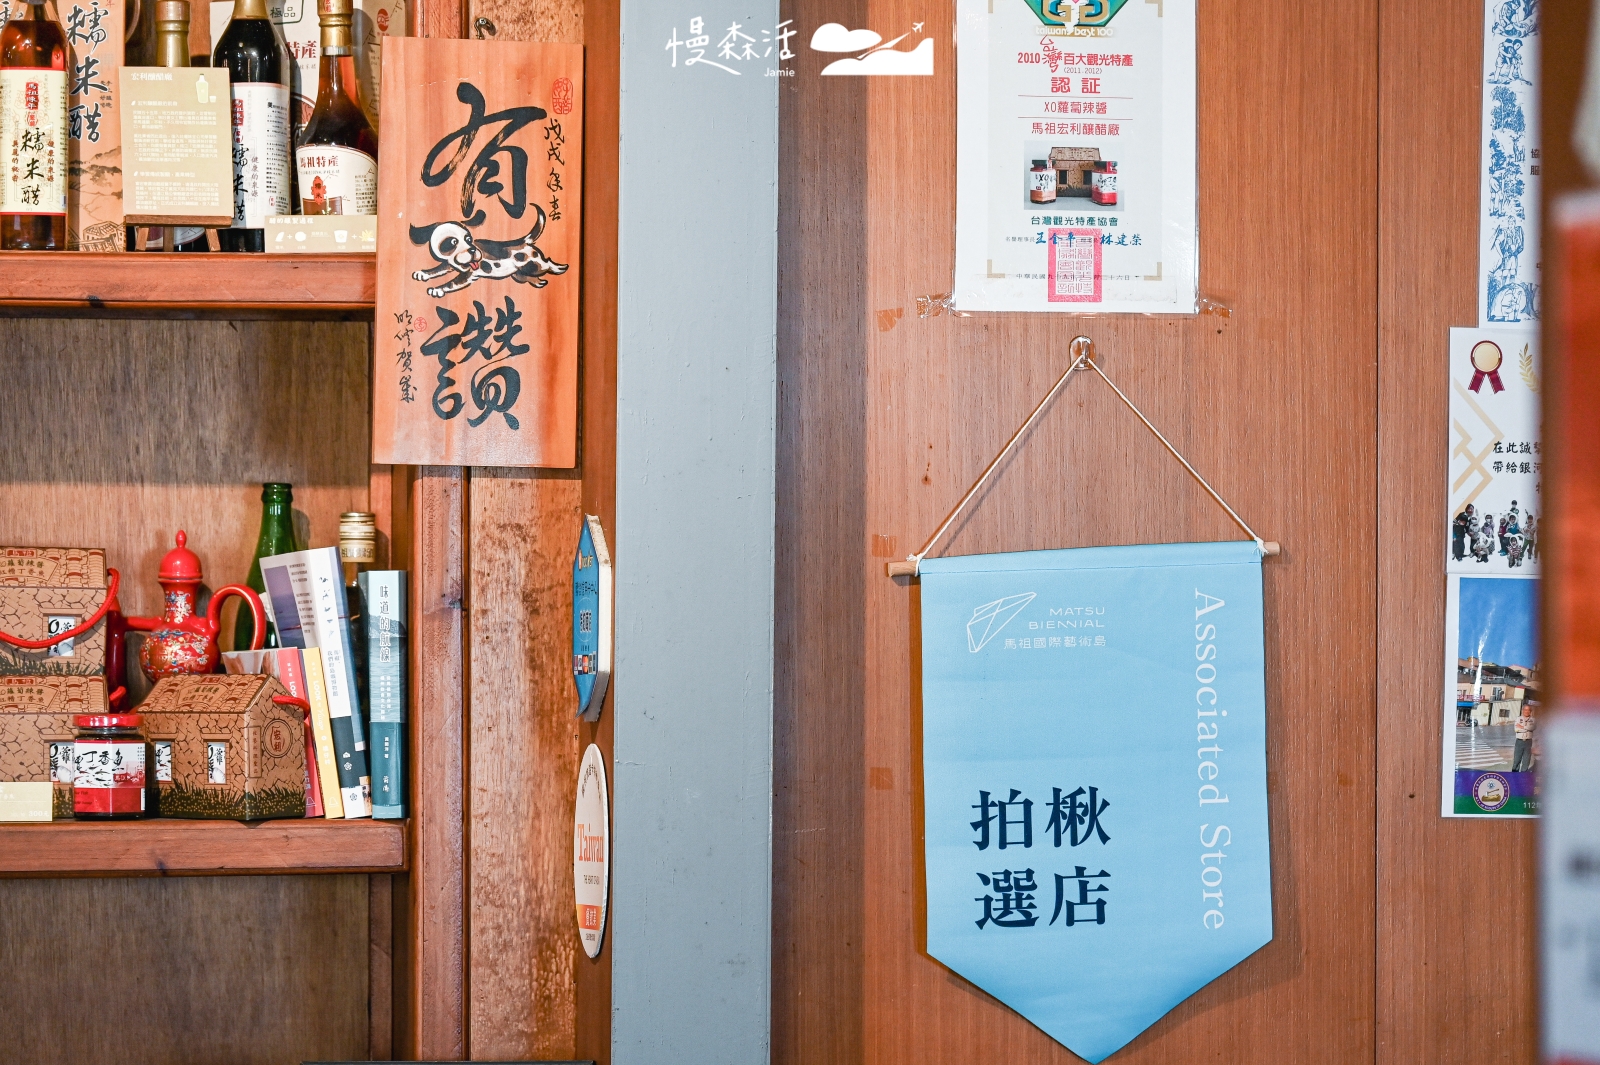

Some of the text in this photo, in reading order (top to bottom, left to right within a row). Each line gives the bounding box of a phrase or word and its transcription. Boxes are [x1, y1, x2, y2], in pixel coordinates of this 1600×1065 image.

[1031, 122, 1120, 136] 馬祖宏利釀醋廠
[1031, 215, 1118, 227] 台灣觀光特產協會
[420, 295, 531, 431] 讚
[1049, 606, 1105, 617] MATSU
[1028, 619, 1105, 630] BIENNIAL
[1003, 635, 1107, 650] 馬祖國際藝術島
[289, 681, 297, 697] LOO
[313, 680, 322, 701] LOOK
[1194, 588, 1232, 930] Associated Store
[577, 822, 604, 863] Taiwan
